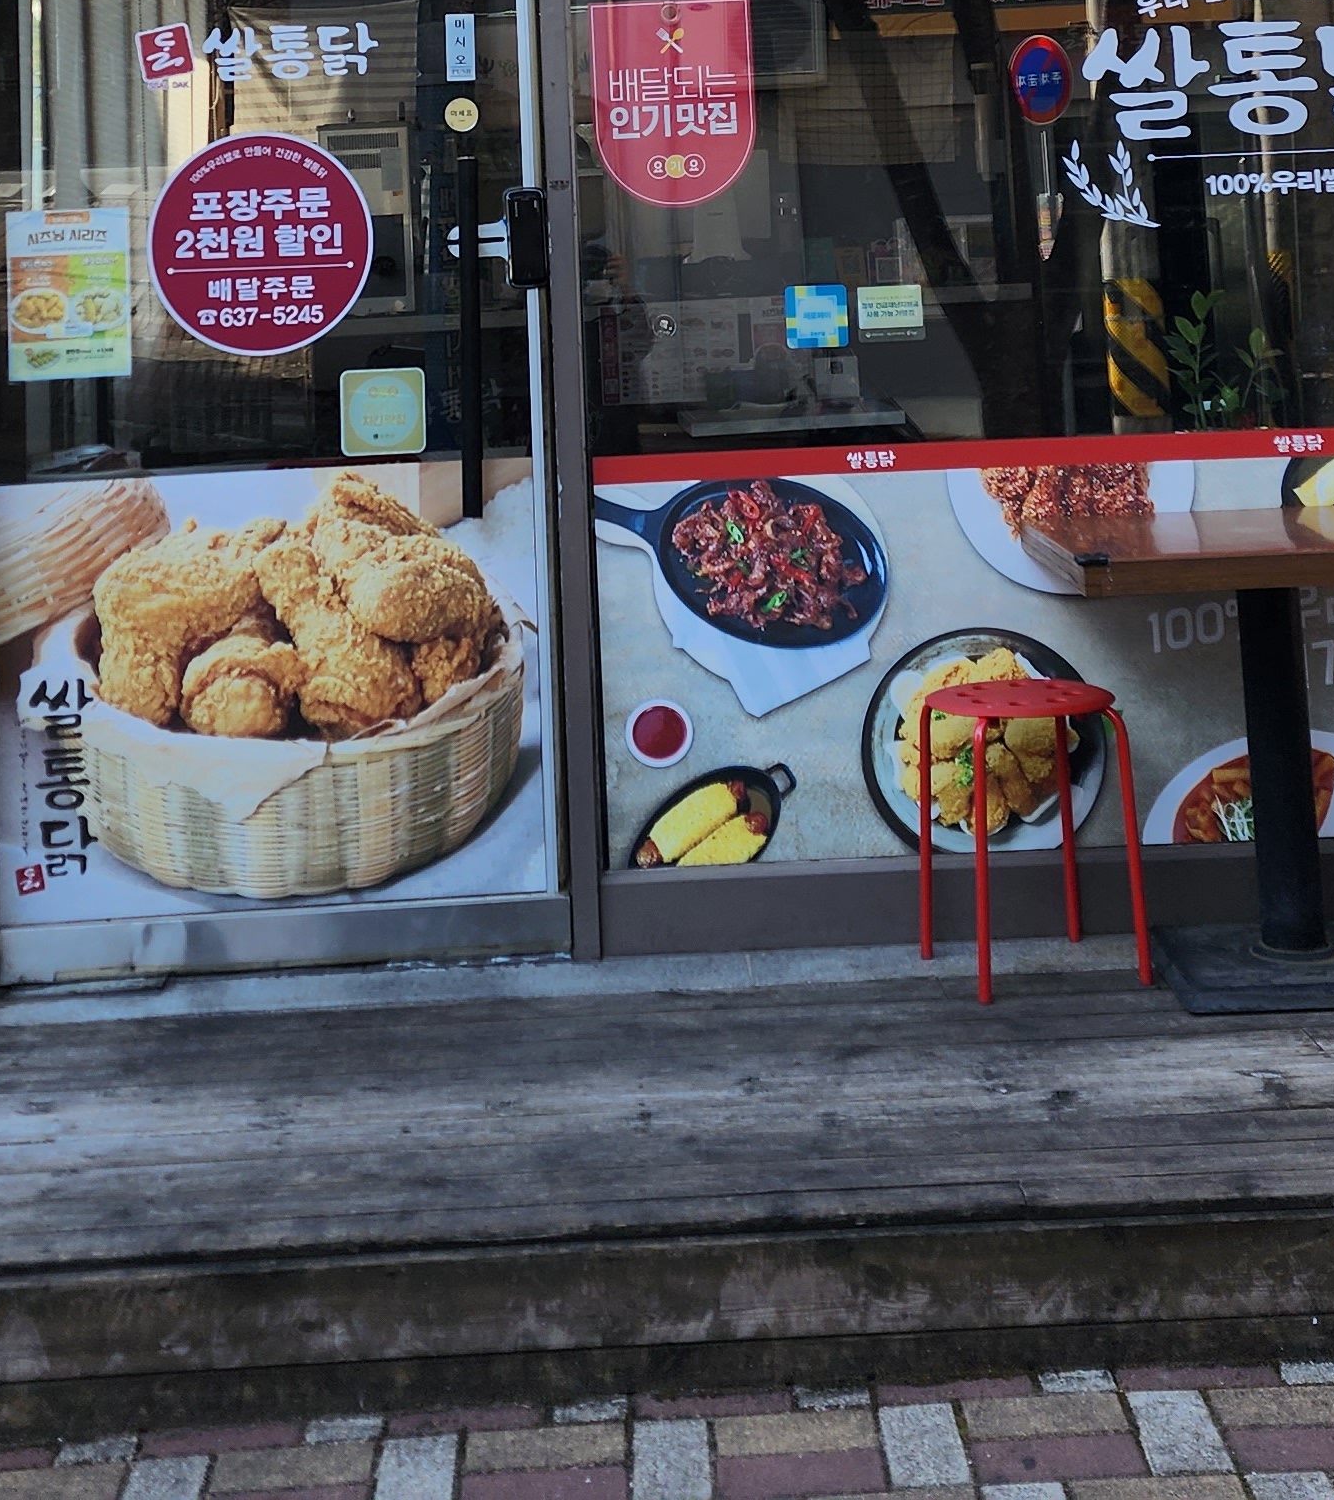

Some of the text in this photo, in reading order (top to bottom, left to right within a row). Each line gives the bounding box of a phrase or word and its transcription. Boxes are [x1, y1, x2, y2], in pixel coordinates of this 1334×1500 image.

[201, 22, 379, 82] 쌀통닭
[454, 18, 467, 65] 미시오
[171, 81, 190, 89] DAK
[607, 65, 738, 103] 배달되는
[609, 101, 738, 140] 인기 맛집
[189, 186, 331, 222] 포장주문
[175, 222, 343, 261] 2천원 할인
[207, 275, 316, 302] 배달주문
[219, 305, 325, 328] 637-5245
[846, 449, 897, 471] 쌀통닭
[1272, 432, 1326, 453] 쌀통닭
[28, 678, 99, 878] 쌀통닭
